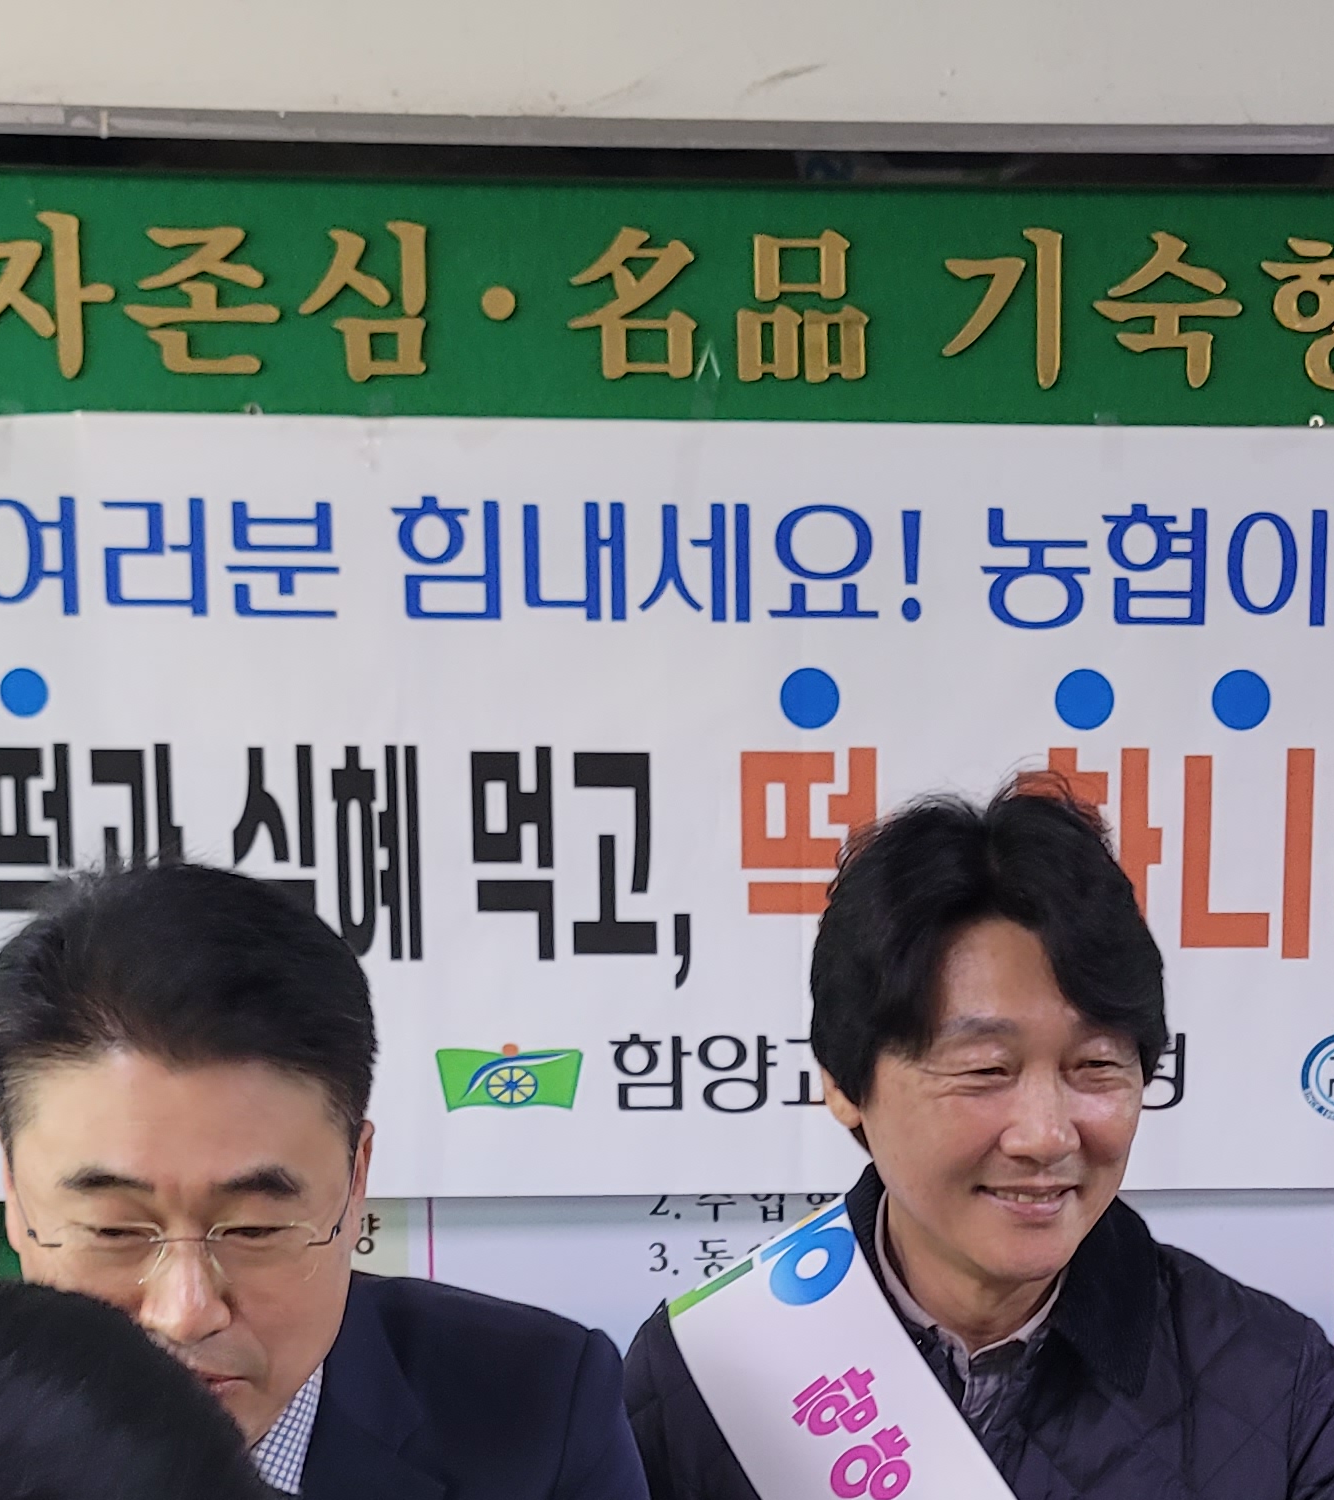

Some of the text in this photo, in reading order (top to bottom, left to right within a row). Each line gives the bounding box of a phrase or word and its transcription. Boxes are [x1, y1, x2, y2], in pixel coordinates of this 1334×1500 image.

[569, 226, 869, 383] 名品
[390, 494, 923, 623] 힘내세요!
[980, 502, 1329, 631] 농협이
[469, 744, 692, 990] 먹고,
[740, 746, 879, 915] 떡
